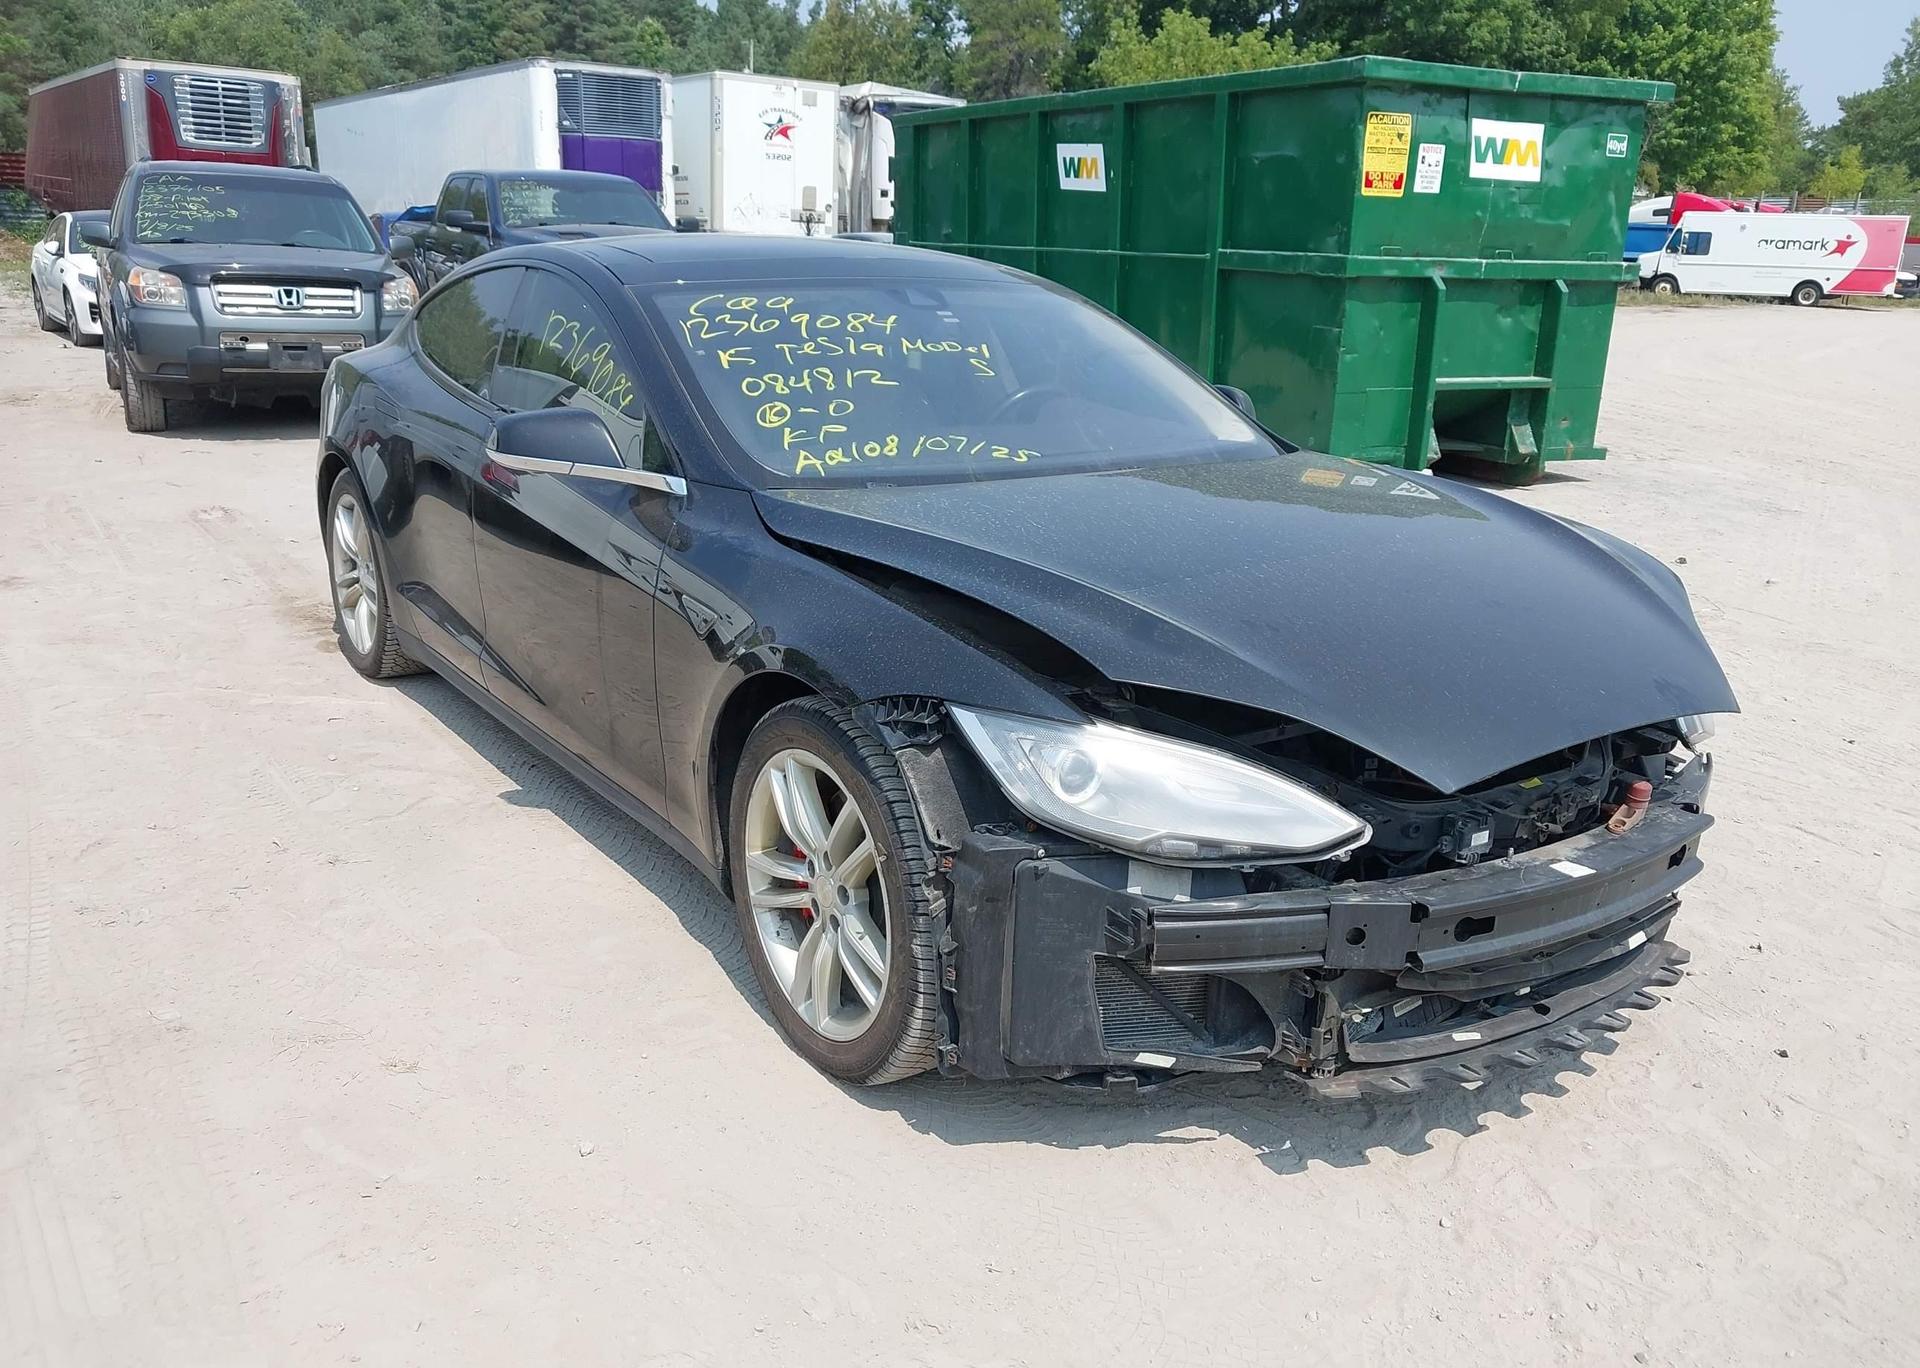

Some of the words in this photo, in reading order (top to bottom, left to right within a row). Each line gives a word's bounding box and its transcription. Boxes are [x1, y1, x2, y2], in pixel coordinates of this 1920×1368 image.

[1377, 115, 1409, 124] CAUTION
[1422, 145, 1443, 154] NOTICE
[1474, 135, 1540, 167] WM
[1608, 139, 1626, 153] 40yd
[1063, 157, 1099, 179] WM
[1368, 171, 1381, 180] DO
[1383, 172, 1401, 182] NOT
[1372, 180, 1394, 189] PARK
[1757, 238, 1830, 251] aramark
[679, 312, 898, 347] 12369084
